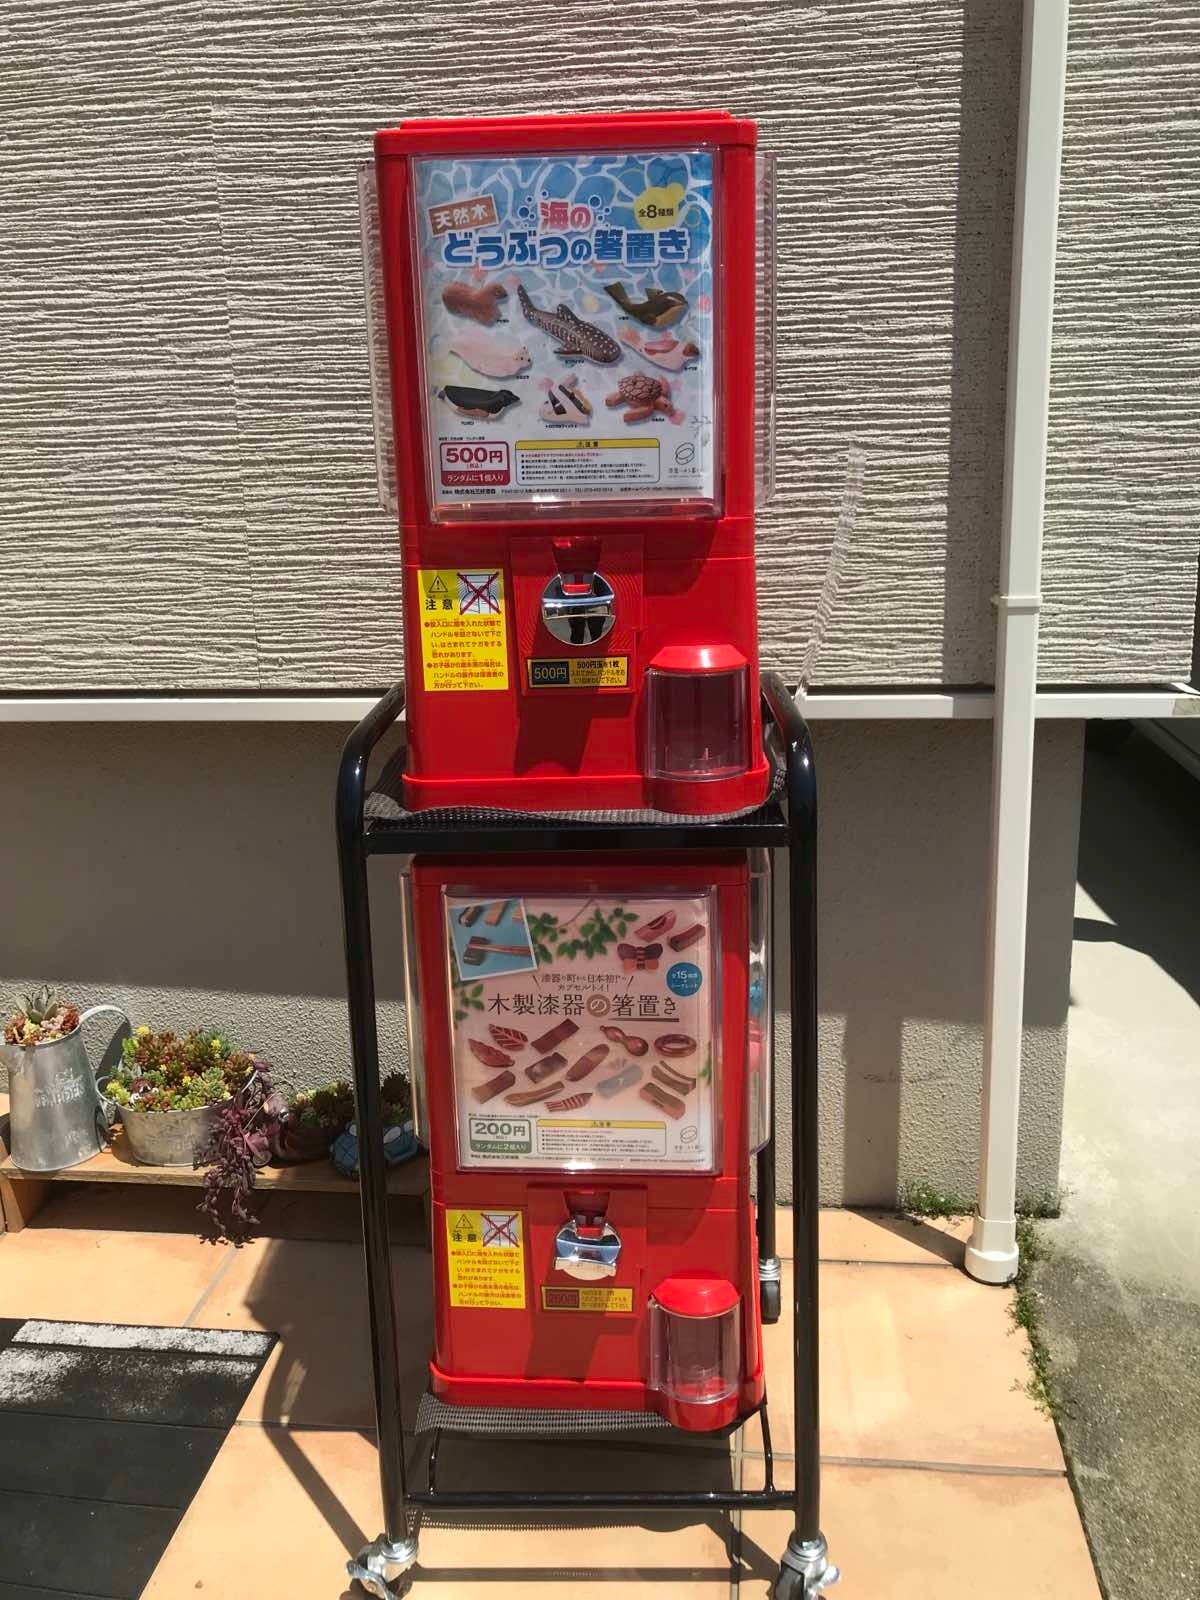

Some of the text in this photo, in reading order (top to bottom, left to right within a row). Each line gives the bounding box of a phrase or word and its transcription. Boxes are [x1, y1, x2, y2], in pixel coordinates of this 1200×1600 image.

[434, 202, 490, 230] 天然木
[539, 201, 592, 229] 海の
[637, 204, 674, 219] 全8種類
[444, 229, 688, 267] どうぶつの箸置き
[446, 447, 503, 463] 500円
[534, 667, 567, 680] 500円
[487, 993, 678, 1018] 木製漆器の箸置き
[474, 1121, 526, 1137] 200円
